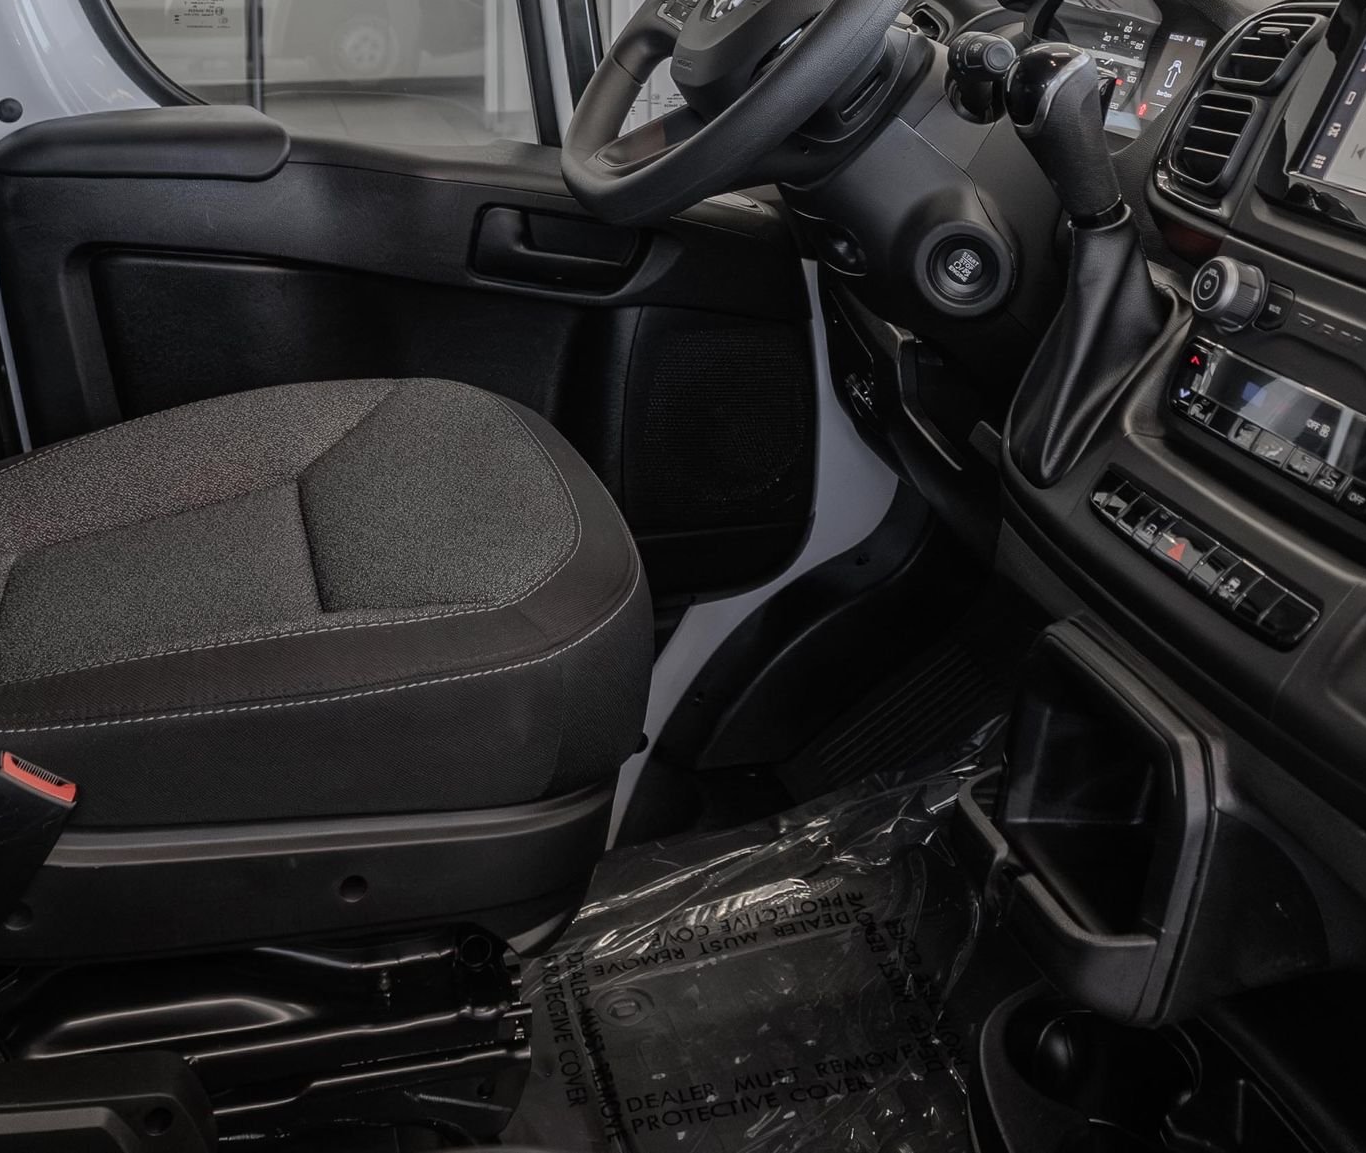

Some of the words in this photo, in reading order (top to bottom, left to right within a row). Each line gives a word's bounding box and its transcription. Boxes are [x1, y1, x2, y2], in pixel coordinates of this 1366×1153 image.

[959, 257, 974, 270] STOP
[963, 251, 980, 266] START
[1306, 419, 1320, 431] OFF
[1347, 492, 1366, 505] OFF
[720, 893, 843, 933] PROTECTIVE
[773, 910, 848, 939] DEALER
[698, 931, 758, 955] MUST
[593, 948, 685, 977] REMOVE
[558, 1050, 588, 1108] COVER
[626, 1081, 715, 1113] DEALER
[734, 1067, 800, 1093] MUST
[631, 1094, 781, 1135] PROTECTIVE
